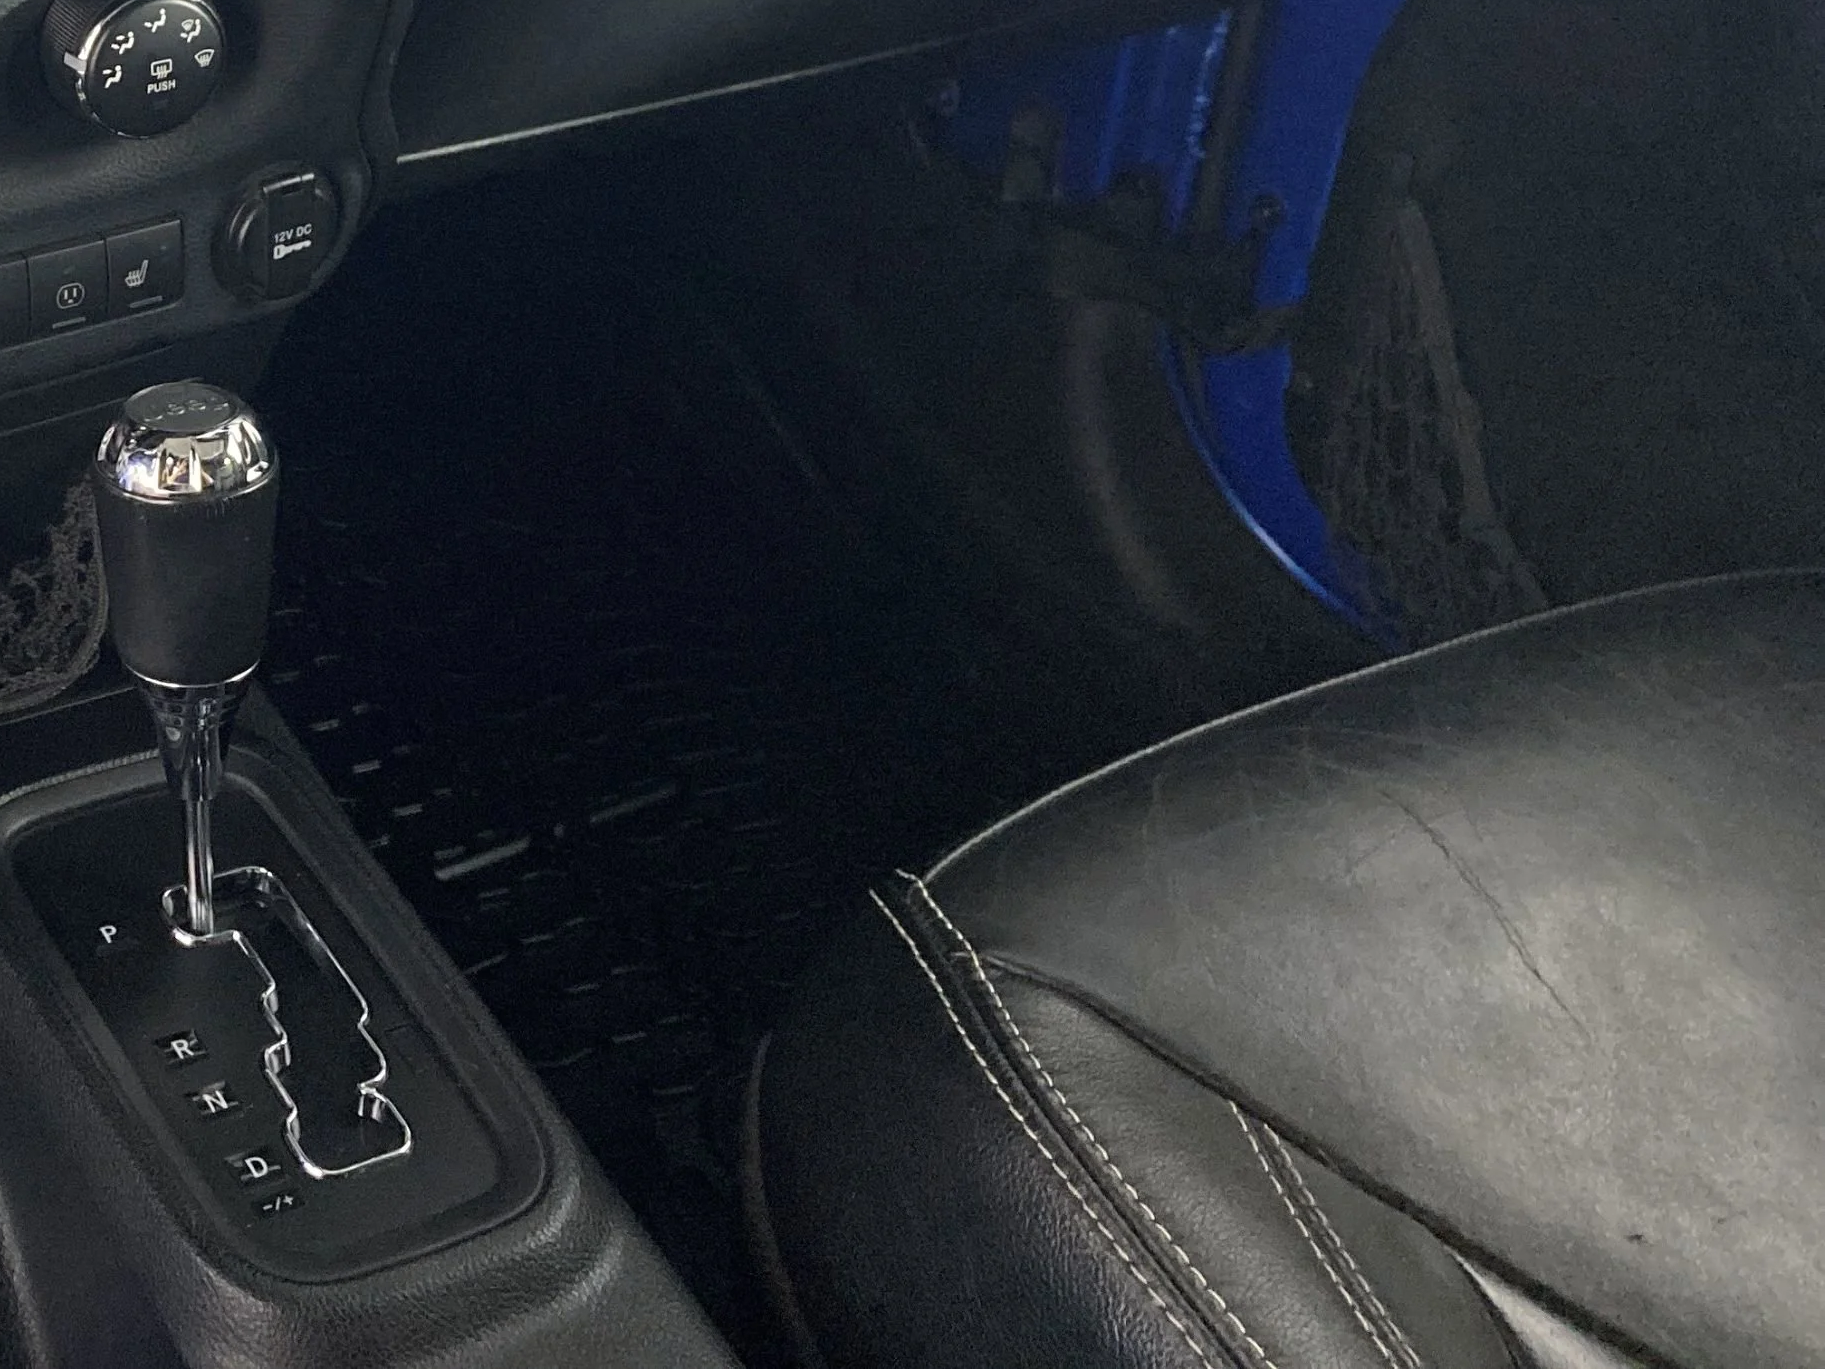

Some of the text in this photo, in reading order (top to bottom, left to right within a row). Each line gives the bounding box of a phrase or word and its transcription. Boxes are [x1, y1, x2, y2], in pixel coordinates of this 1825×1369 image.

[146, 77, 177, 95] PUSH
[274, 223, 313, 244] 12V DC
[99, 924, 117, 944] P
[170, 1038, 195, 1060] R
[202, 1090, 229, 1114] N
[244, 1156, 269, 1178] D
